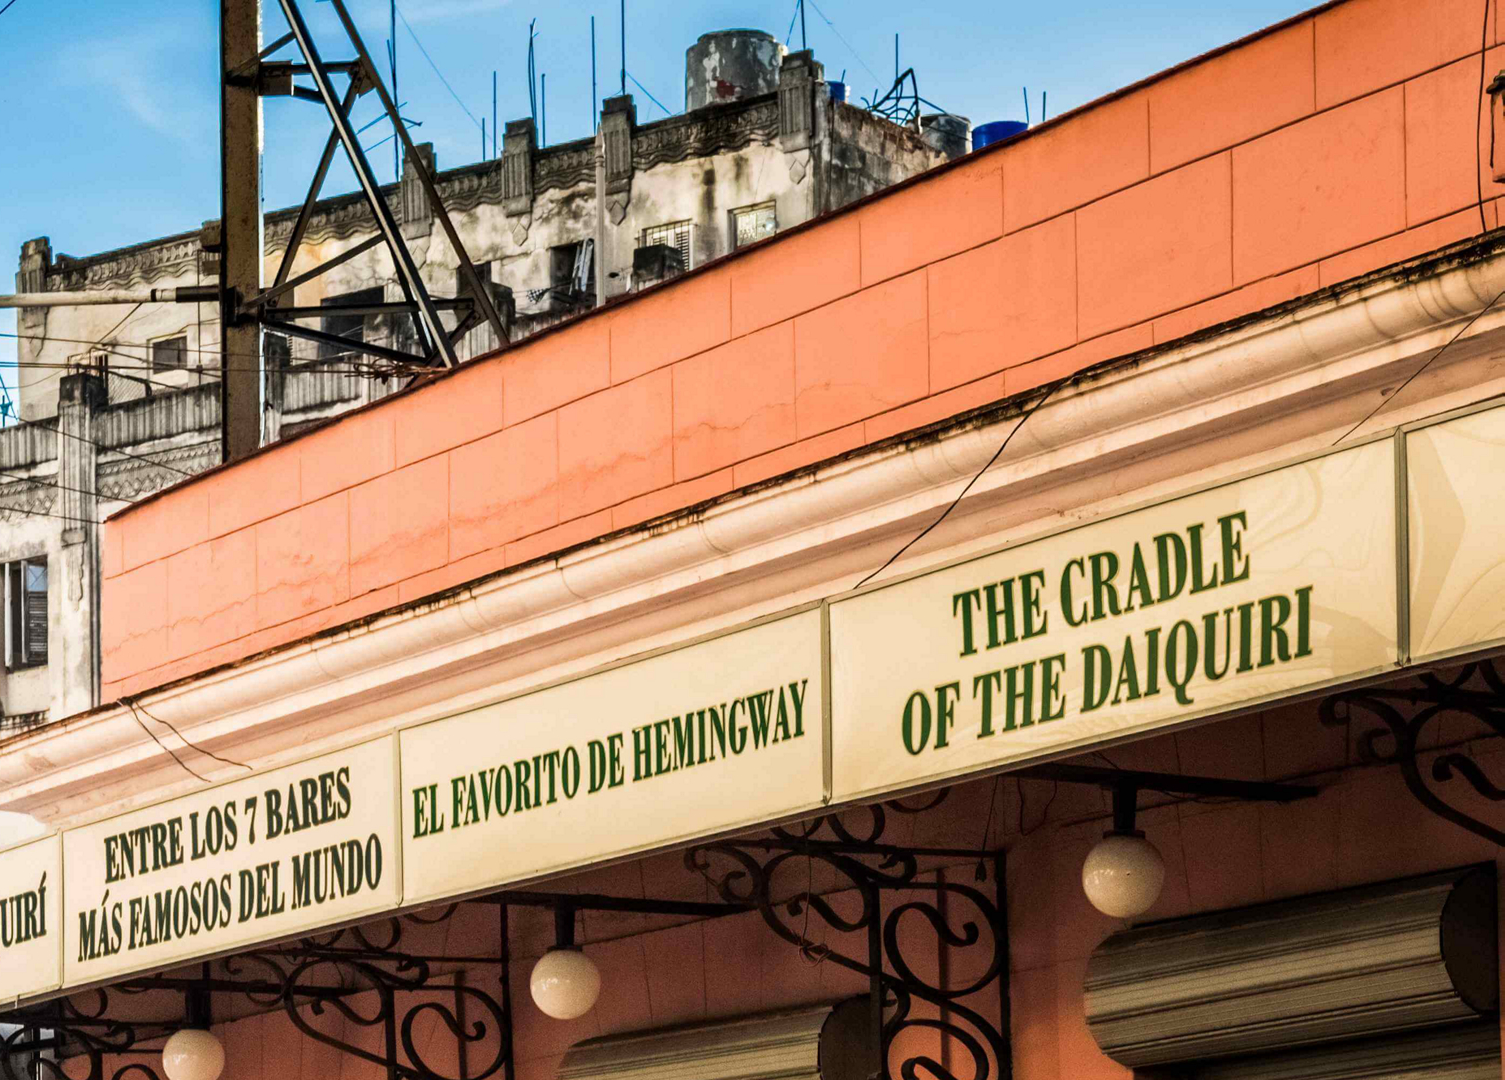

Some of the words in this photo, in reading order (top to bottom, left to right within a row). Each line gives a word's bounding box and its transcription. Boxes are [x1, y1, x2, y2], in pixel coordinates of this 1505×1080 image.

[953, 568, 1048, 658] THE
[1059, 510, 1250, 627] CRADLE
[901, 679, 960, 756] OF
[973, 653, 1066, 739] THE
[1080, 585, 1314, 714] DAIQUIRI
[103, 816, 184, 884] ENTRE
[189, 801, 237, 863] LOS
[243, 796, 258, 844] 7
[265, 766, 352, 841] BARES
[412, 783, 444, 839] EL
[451, 745, 580, 830] FAVORITO
[587, 733, 625, 794] DE
[632, 678, 808, 783] HEMINGWAY
[77, 890, 123, 962] MÁS
[128, 878, 233, 950] FAMOSOS
[238, 860, 285, 923] DEL
[291, 833, 383, 910] MUNDO
